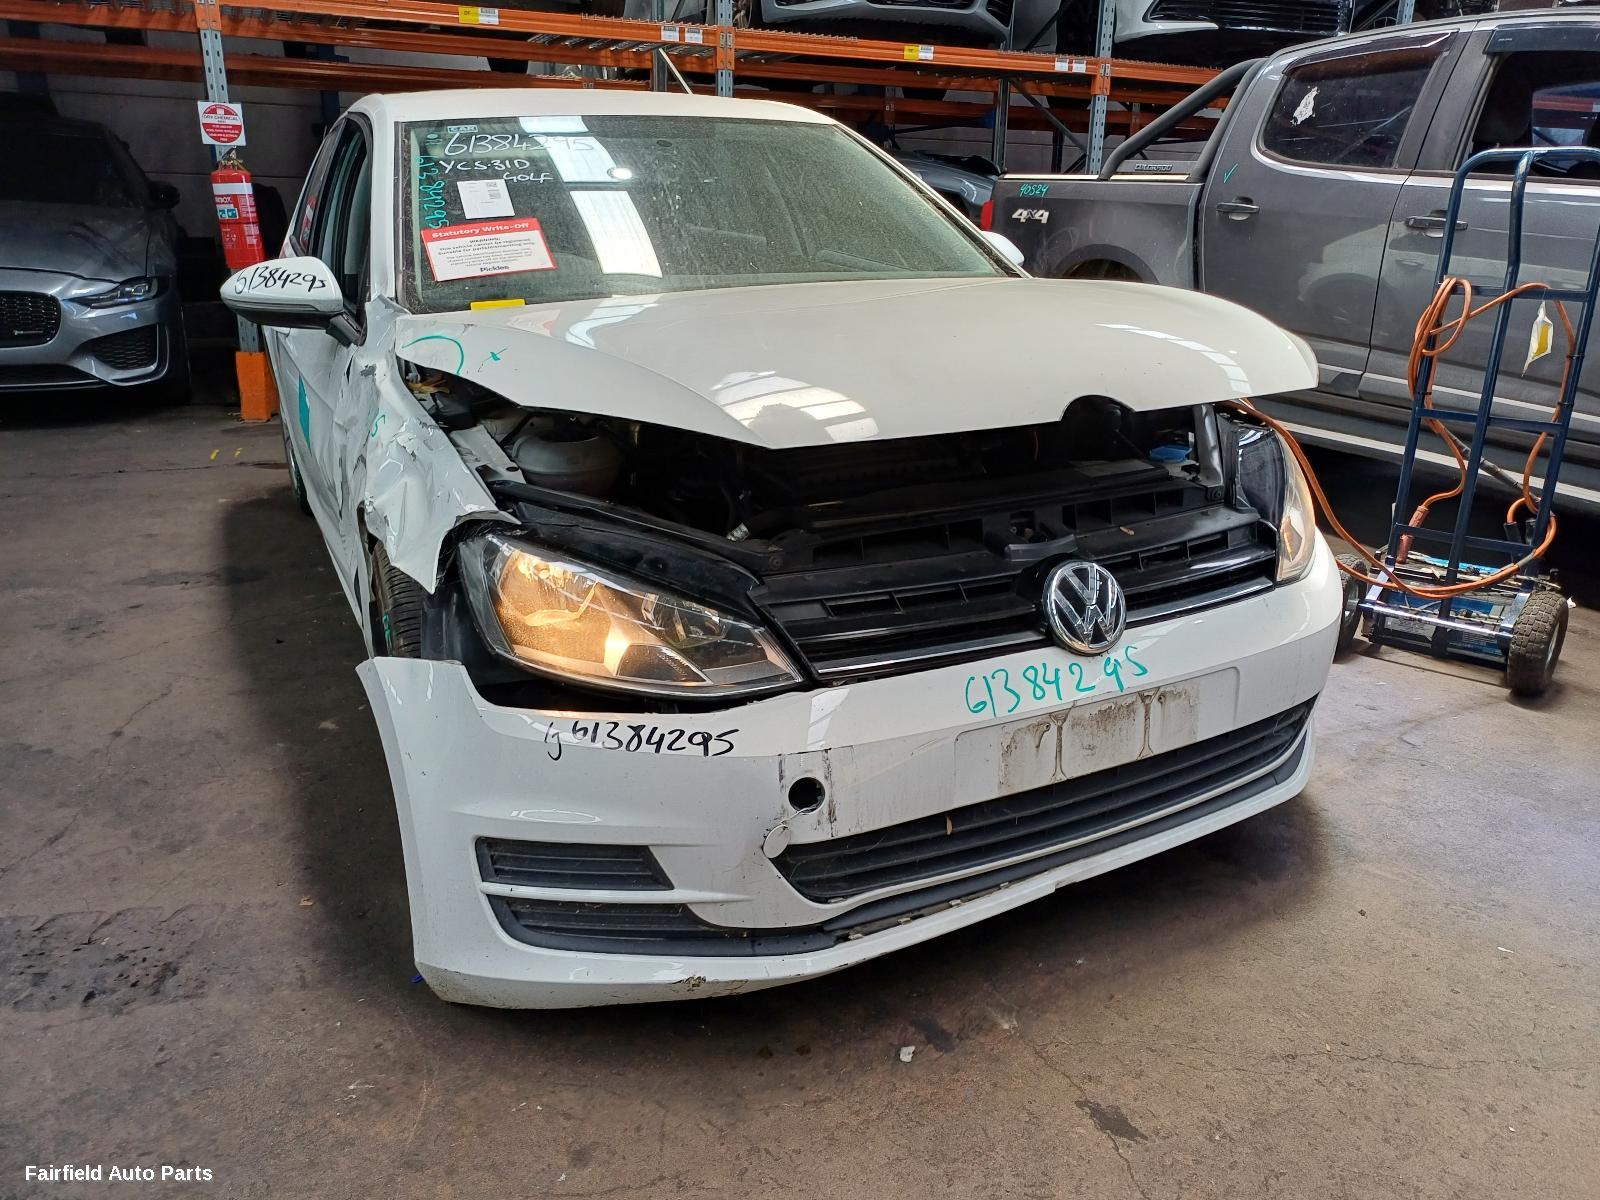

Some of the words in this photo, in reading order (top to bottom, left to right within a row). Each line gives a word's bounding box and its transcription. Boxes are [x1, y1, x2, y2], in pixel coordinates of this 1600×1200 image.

[444, 132, 594, 156] 61384295
[502, 172, 554, 183] GOLF
[431, 227, 480, 239] Statutory
[481, 222, 529, 233] Write-Off
[965, 645, 1149, 718] 61384295
[571, 719, 740, 757] 61384295
